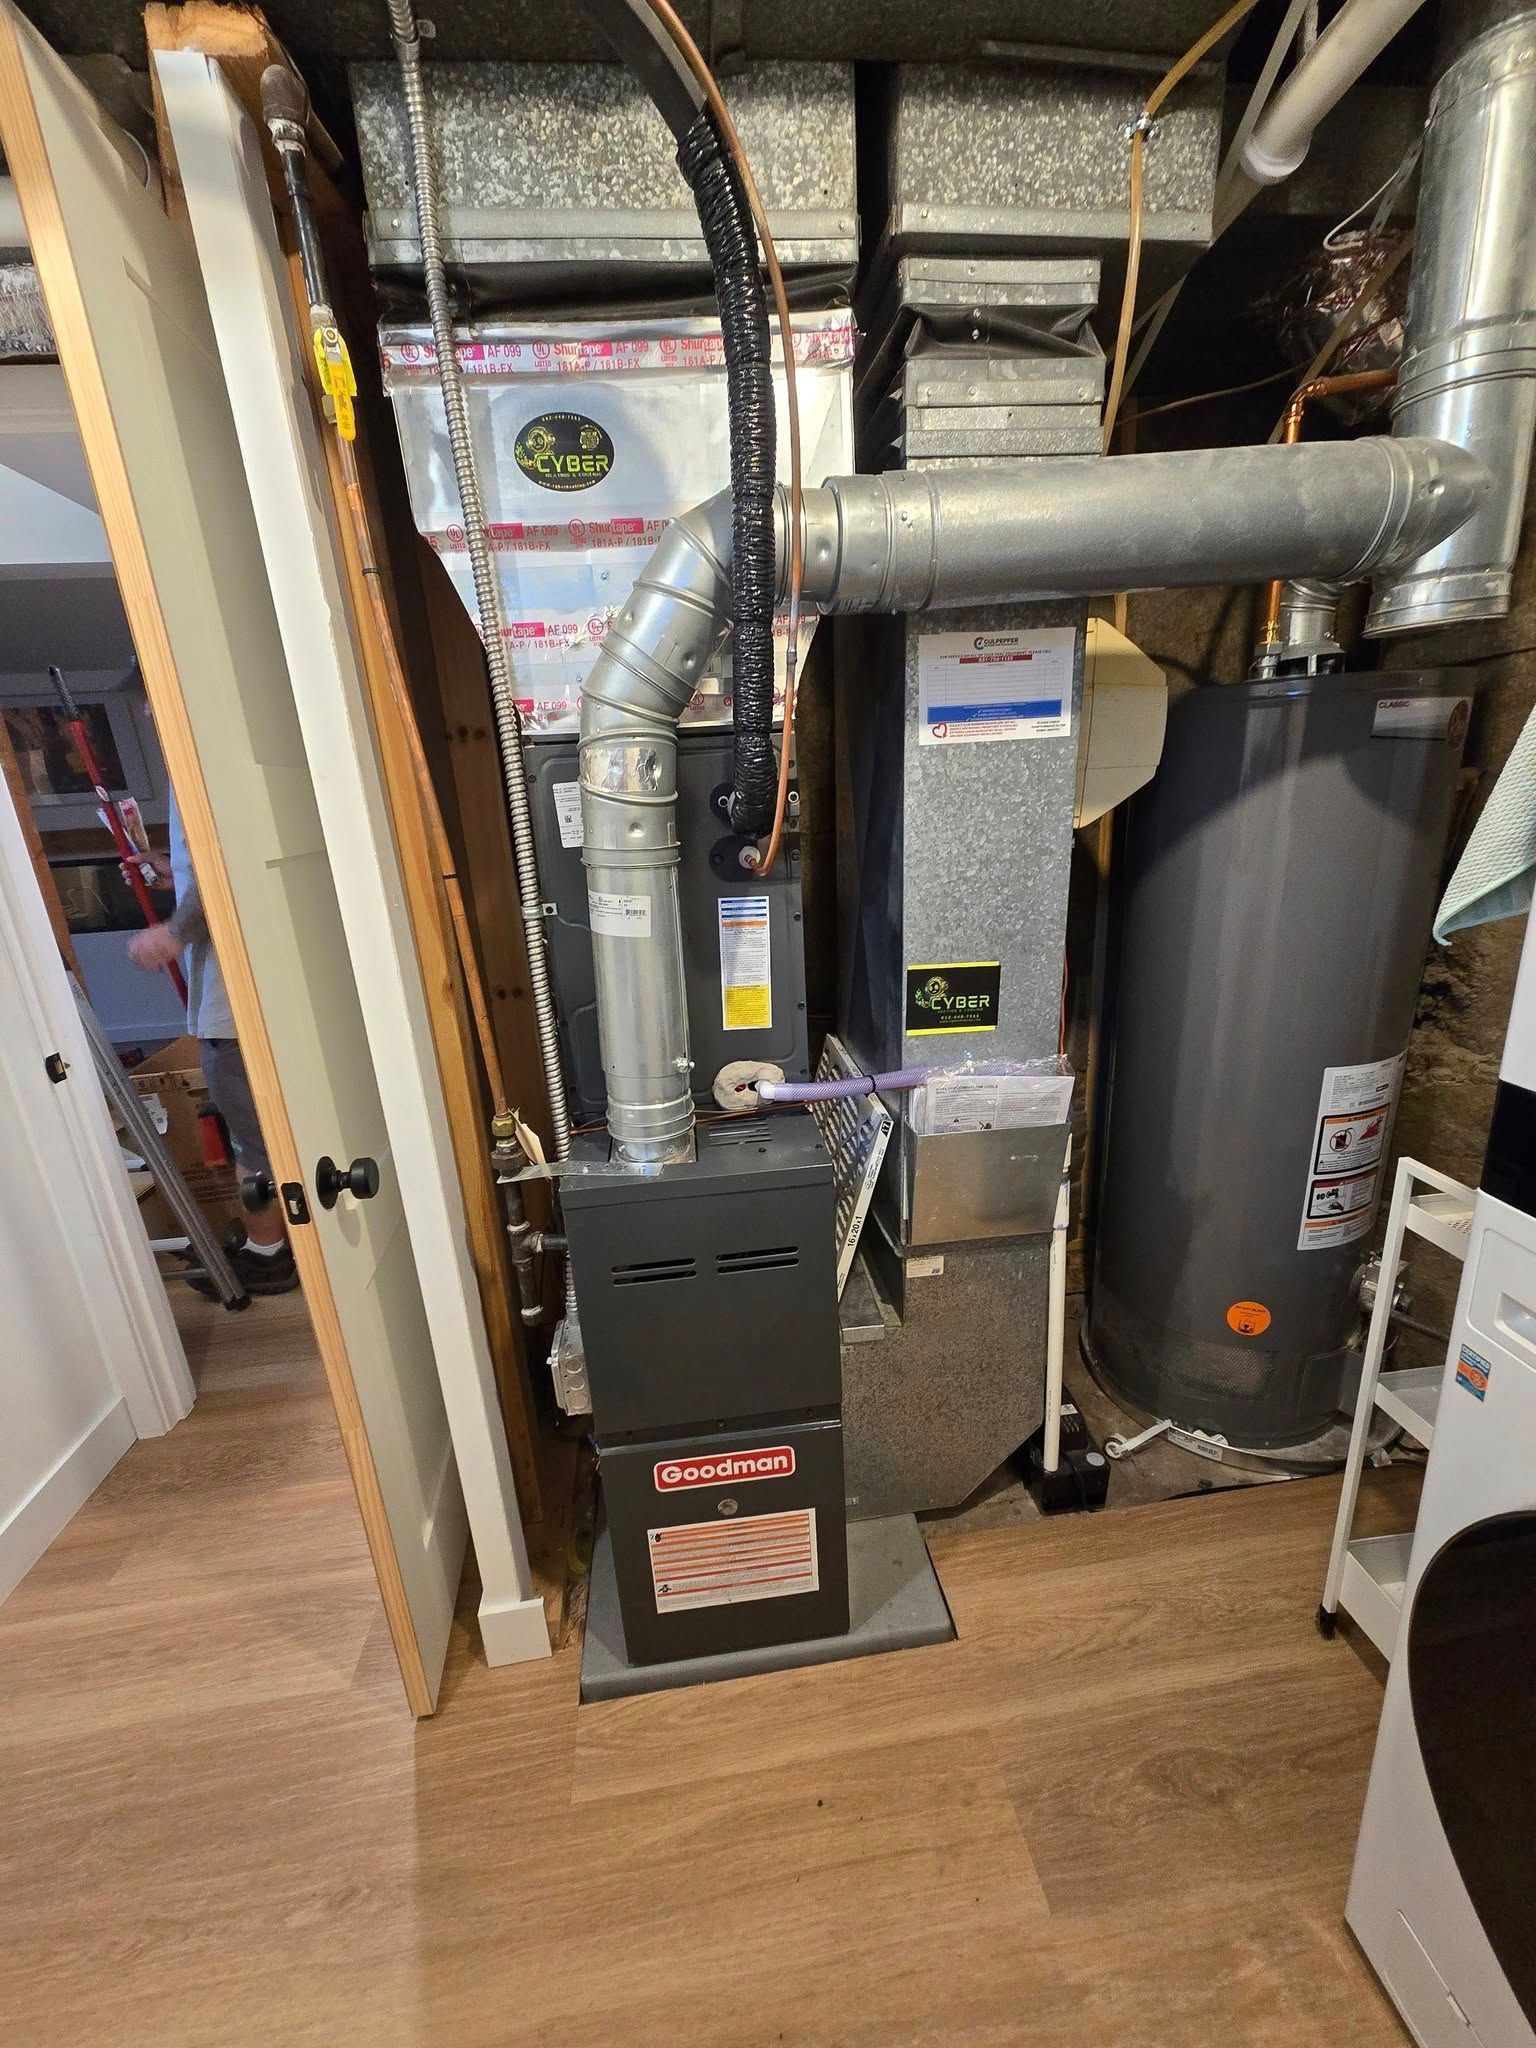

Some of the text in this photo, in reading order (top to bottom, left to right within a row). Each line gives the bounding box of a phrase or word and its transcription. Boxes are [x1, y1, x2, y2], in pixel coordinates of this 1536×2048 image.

[554, 343, 602, 357] Shurtape
[616, 341, 629, 353] AF
[632, 340, 649, 353] 099
[681, 337, 724, 351] Shurtap
[488, 345, 500, 358] AF
[504, 345, 521, 357] 099
[473, 363, 514, 374] 181B-FX
[600, 358, 641, 369] 181B-FX
[537, 454, 609, 473] CYBER
[527, 525, 539, 536] AF
[541, 525, 559, 536] 099
[647, 520, 660, 531] AF
[513, 541, 551, 551] 181B-FX
[548, 624, 559, 635] AF
[562, 624, 578, 634] 099
[537, 701, 567, 710] AF 099
[931, 995, 990, 1010] CYBER
[661, 1455, 788, 1483] Goodman
